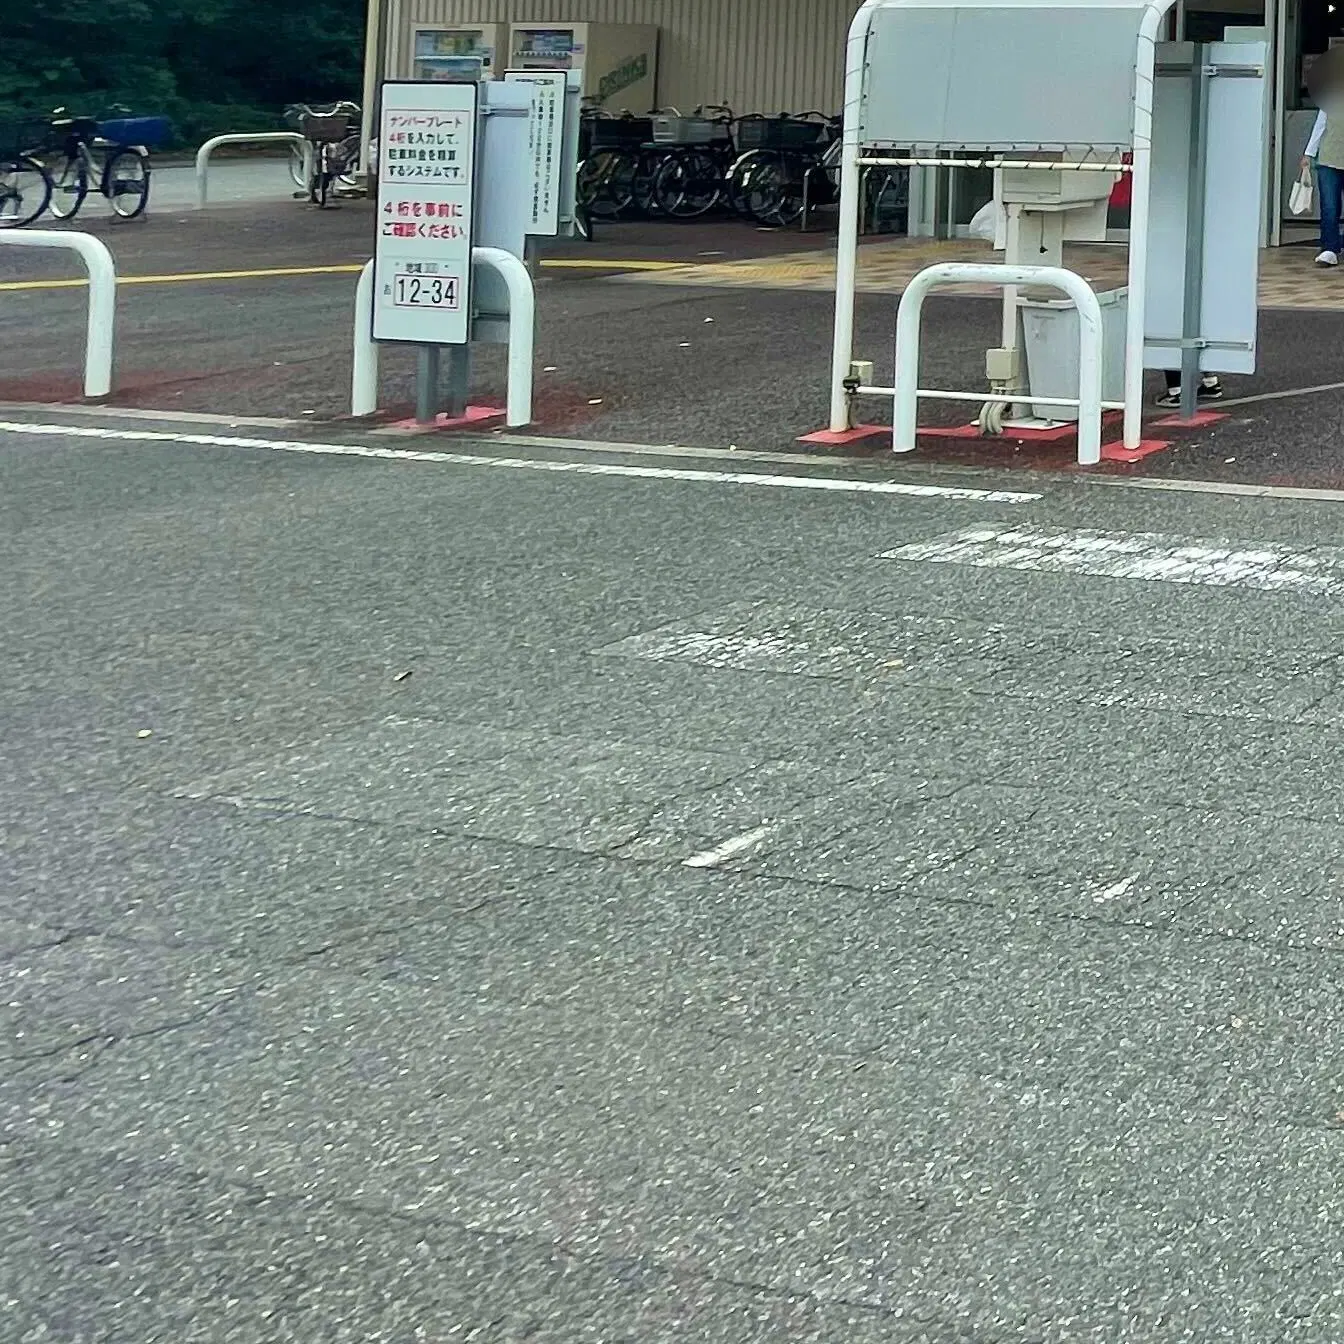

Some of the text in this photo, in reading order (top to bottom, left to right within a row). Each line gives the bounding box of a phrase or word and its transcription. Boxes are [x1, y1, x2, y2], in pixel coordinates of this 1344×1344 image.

[390, 116, 462, 128] ナンバープレート
[398, 279, 456, 305] 12-34
